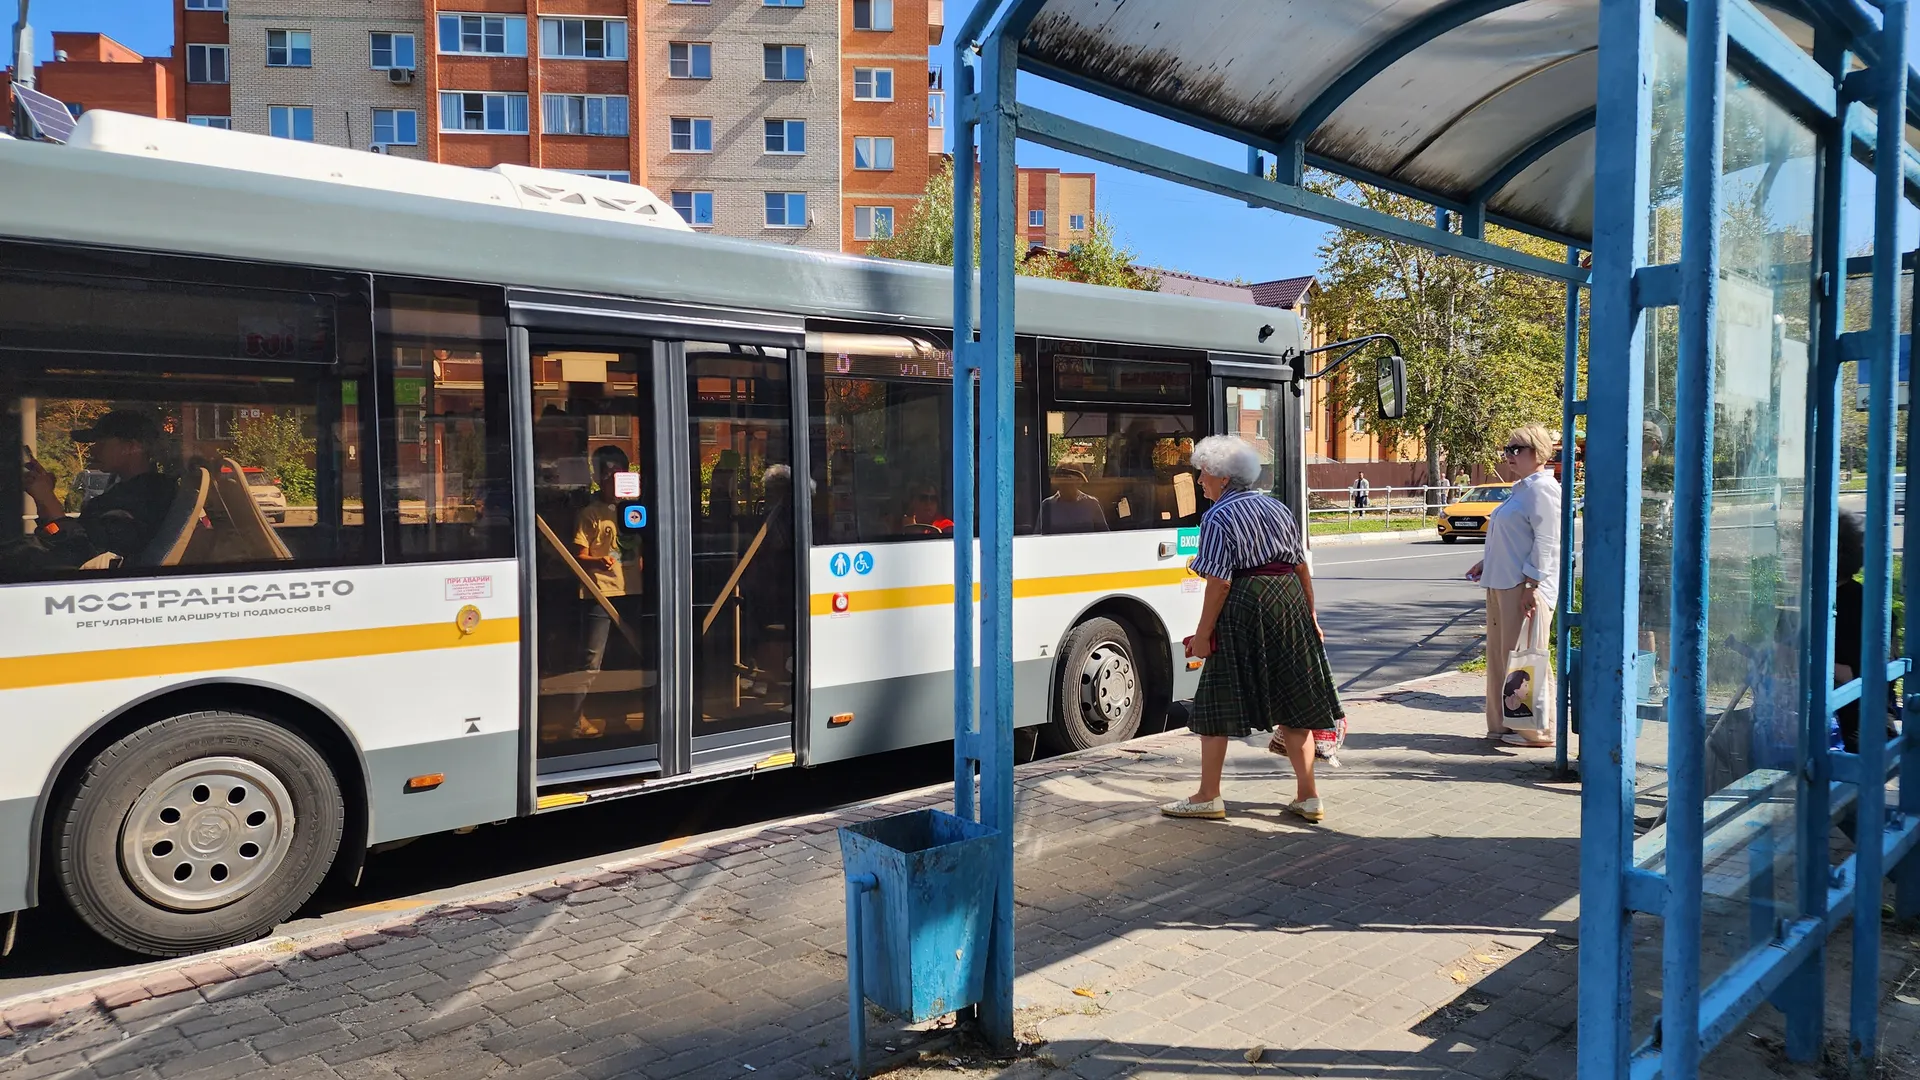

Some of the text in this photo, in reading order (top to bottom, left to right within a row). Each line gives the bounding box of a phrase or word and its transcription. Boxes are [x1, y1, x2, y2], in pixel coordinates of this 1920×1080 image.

[45, 580, 354, 615] МОСТРАНСАВТО
[77, 605, 331, 628] РЕГУЛЯРНЫЕ МАРШРУТЫ ПОДМОСКОВЬЯ
